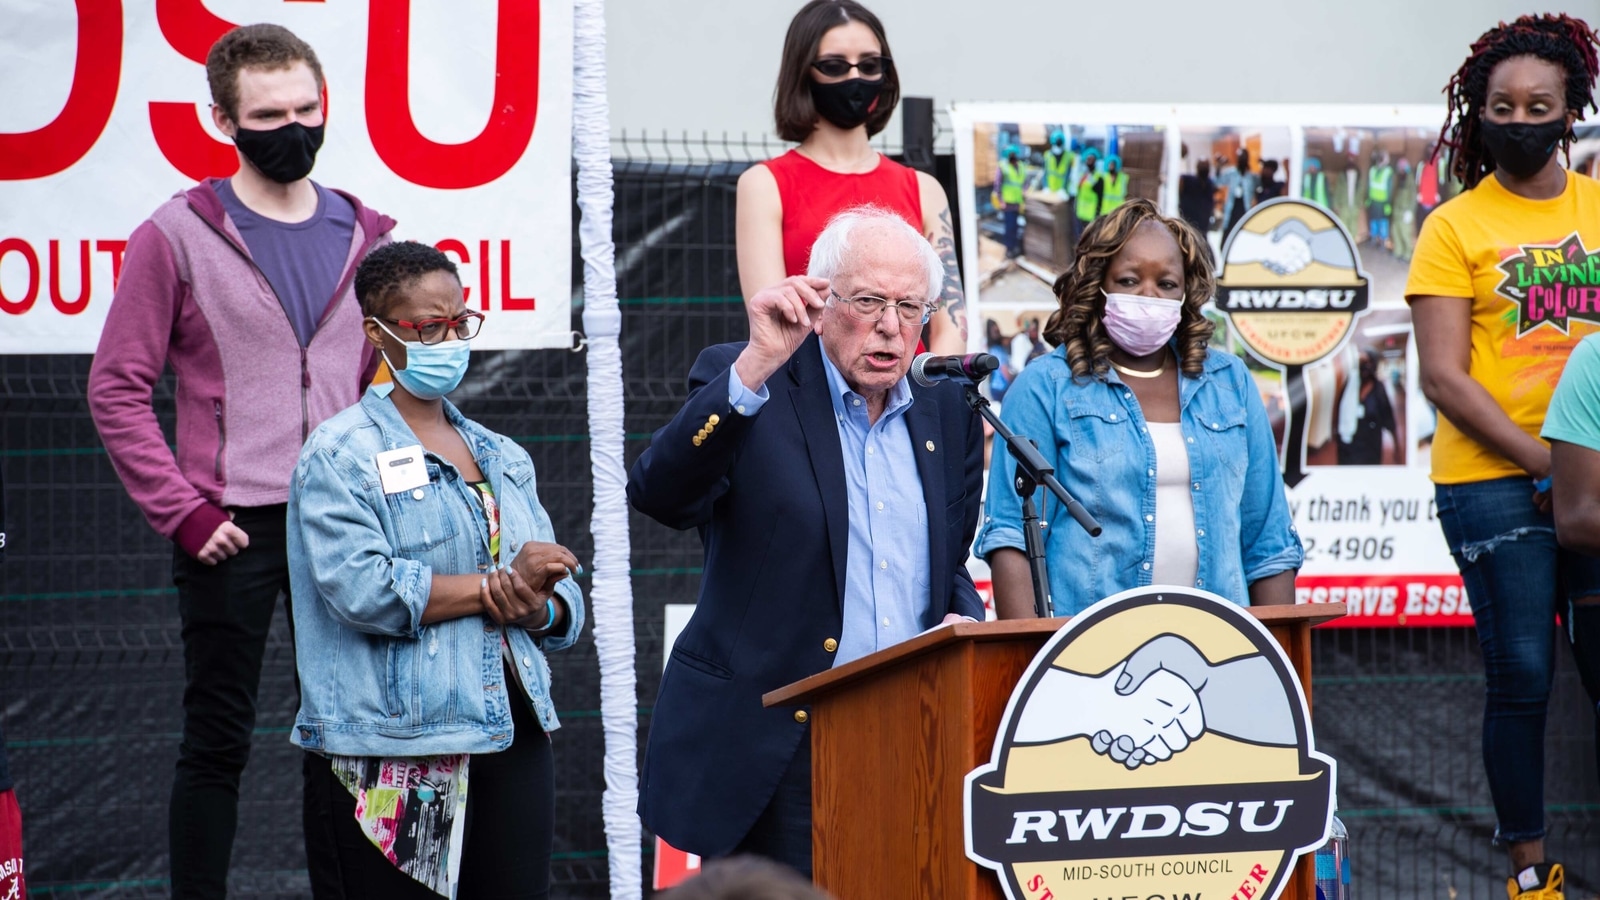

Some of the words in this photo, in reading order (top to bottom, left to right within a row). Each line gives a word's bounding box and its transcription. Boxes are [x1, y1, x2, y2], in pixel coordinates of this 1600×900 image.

[1528, 248, 1565, 267] IN
[1226, 289, 1356, 309] RWDSU
[1308, 493, 1371, 521] thank
[1380, 500, 1419, 526] you
[1304, 536, 1395, 561] 2-4906
[1006, 799, 1294, 844] RWDSU
[1063, 863, 1155, 881] MID-SOUTH
[1161, 859, 1233, 876] COUNCIL
